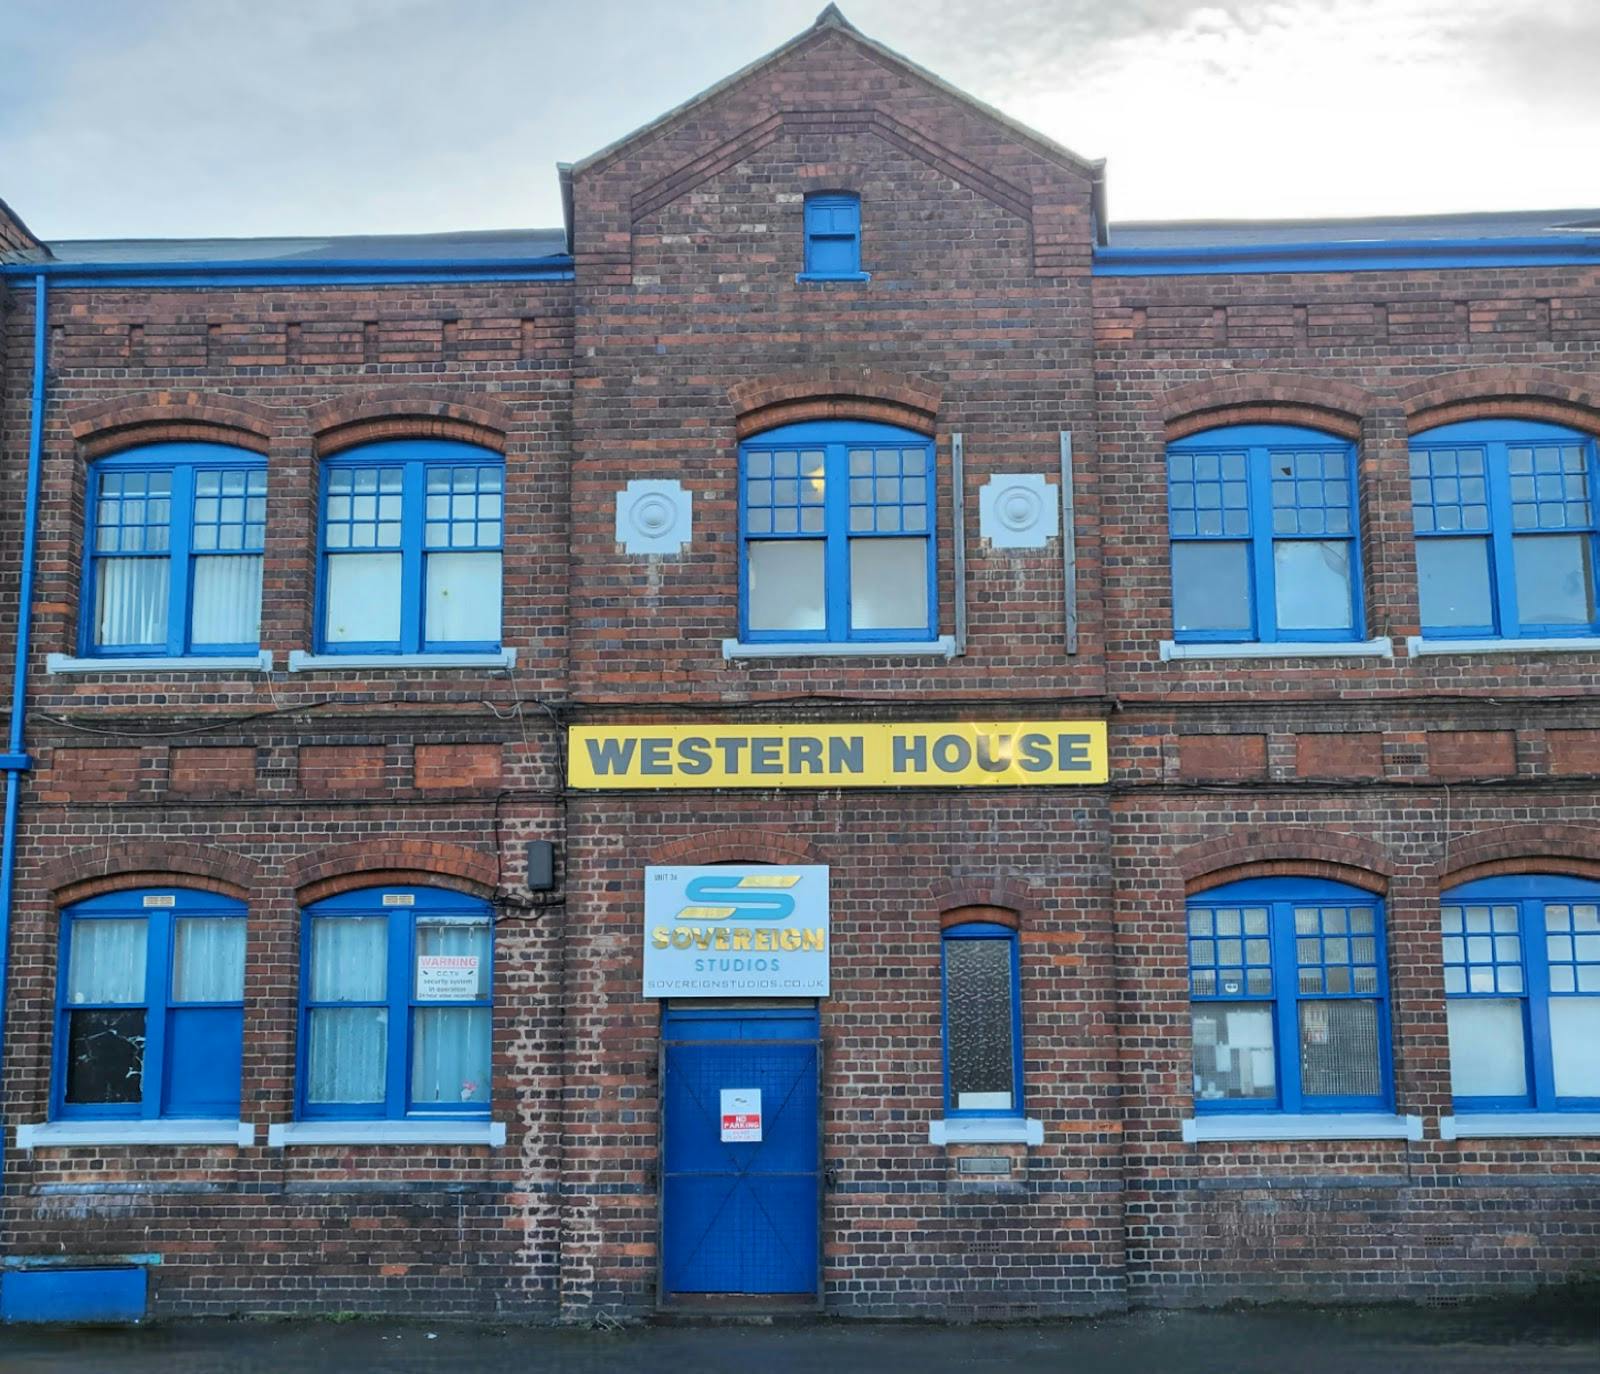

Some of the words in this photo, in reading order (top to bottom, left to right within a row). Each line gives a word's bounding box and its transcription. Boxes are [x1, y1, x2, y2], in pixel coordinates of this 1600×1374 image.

[585, 735, 864, 776] WESTERN
[892, 733, 1092, 773] HOUSE
[654, 873, 668, 881] UNIT
[651, 926, 825, 952] SOVEREIGN
[422, 957, 477, 967] WARNING
[695, 958, 780, 972] STUDIOS
[648, 979, 824, 989] SOVEREIGNSTUDIOS.CO.UK
